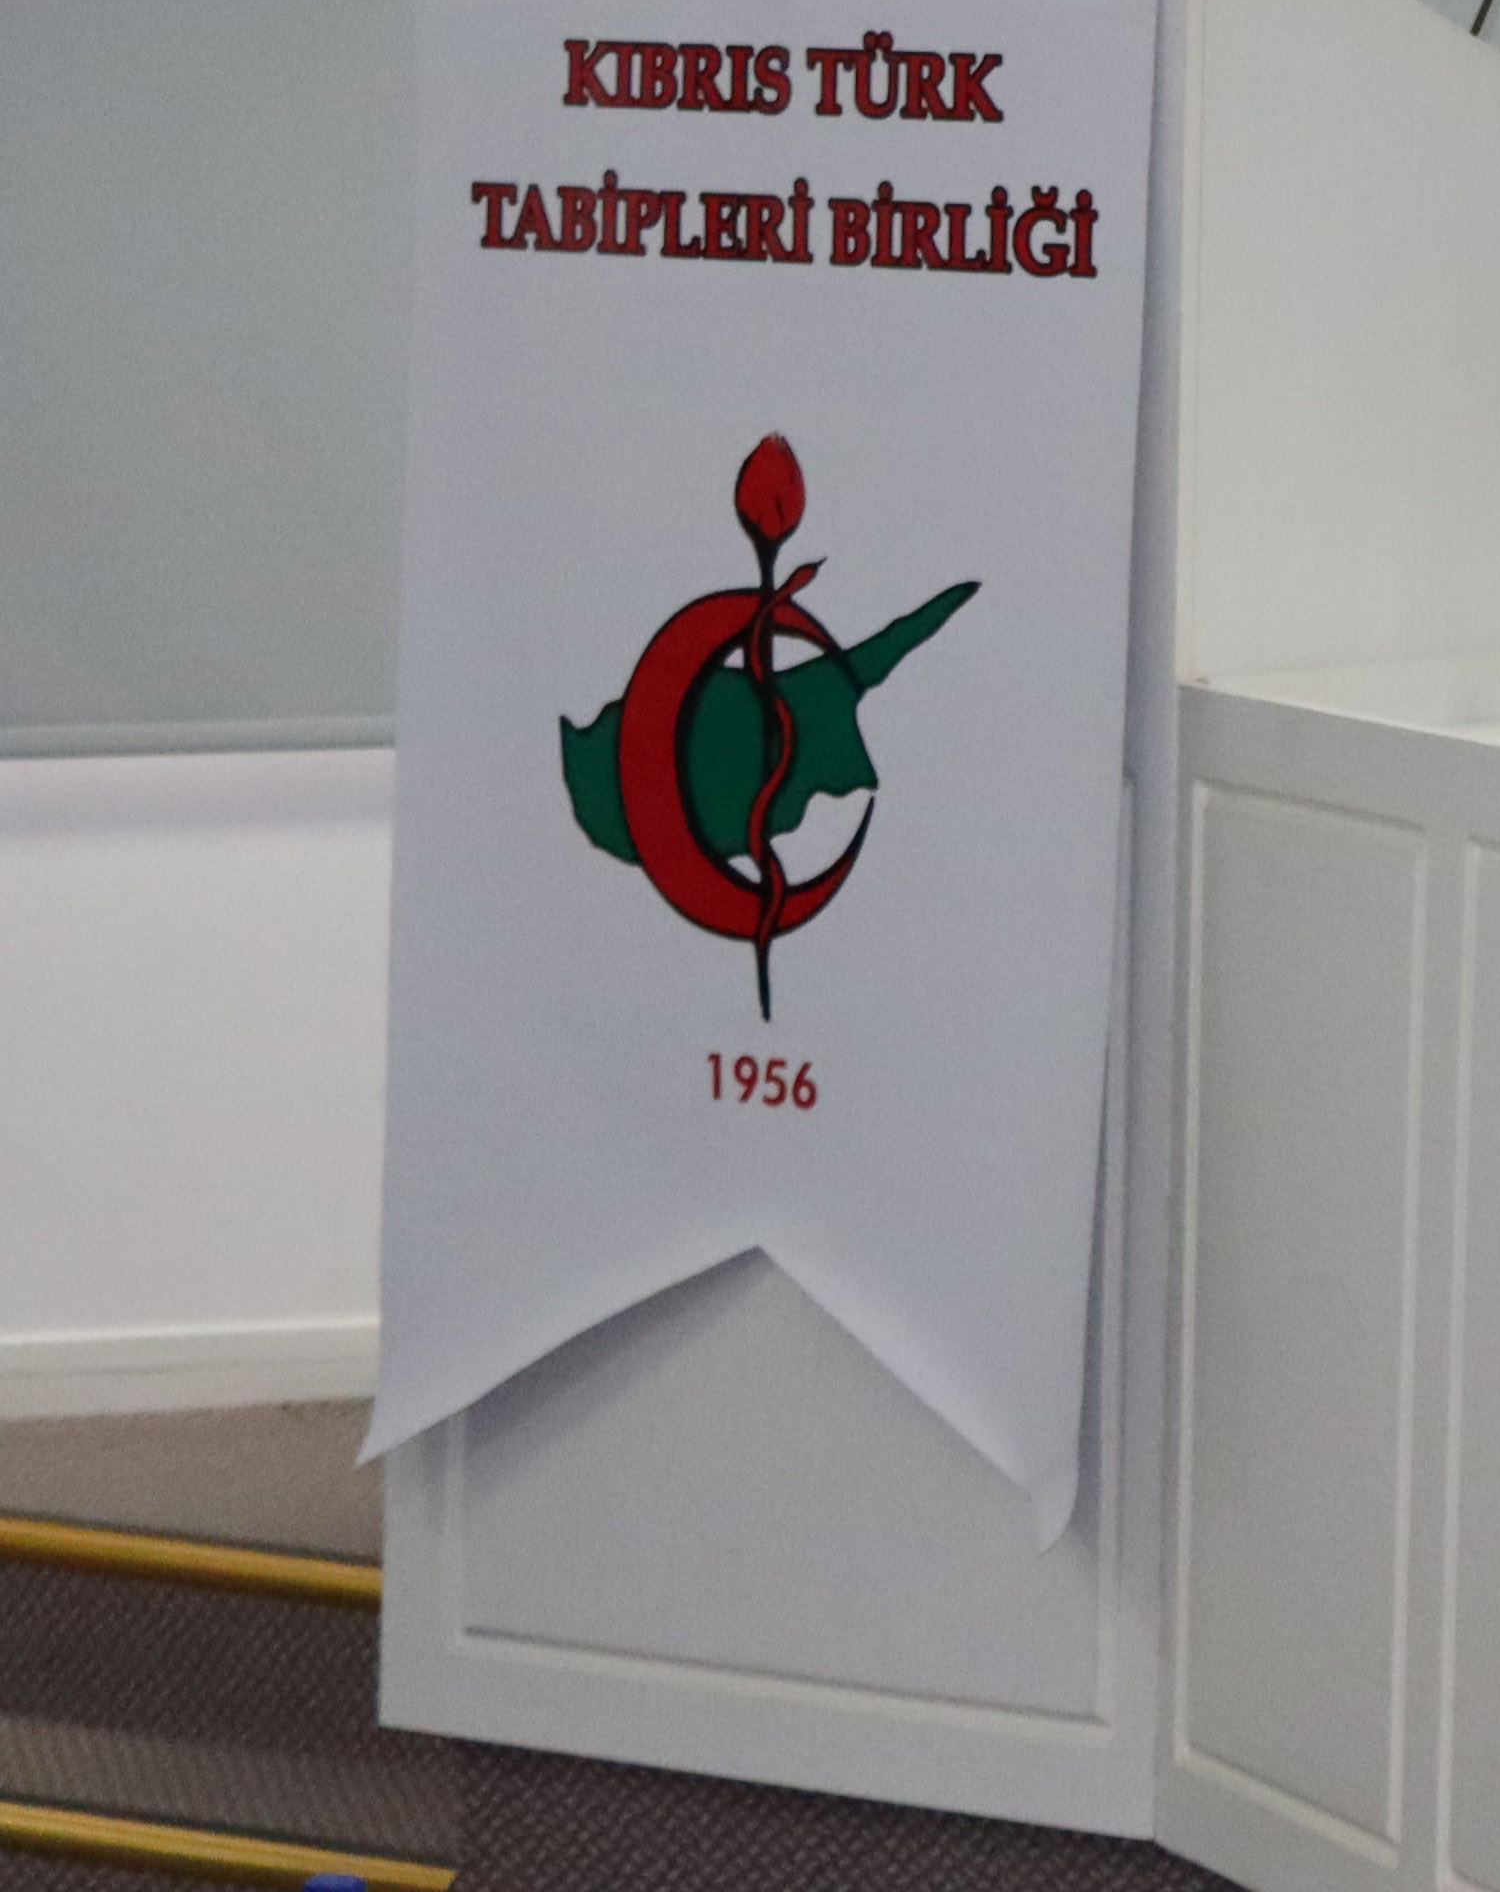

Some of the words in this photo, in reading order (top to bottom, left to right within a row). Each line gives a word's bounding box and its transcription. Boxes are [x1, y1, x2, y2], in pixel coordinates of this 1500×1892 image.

[562, 38, 792, 116] KIBRIS
[805, 30, 1004, 123] TÜRK
[471, 168, 815, 265] TABİPLERİ
[828, 182, 1098, 279] BİRLİĞİ
[707, 1052, 818, 1111] 1956
